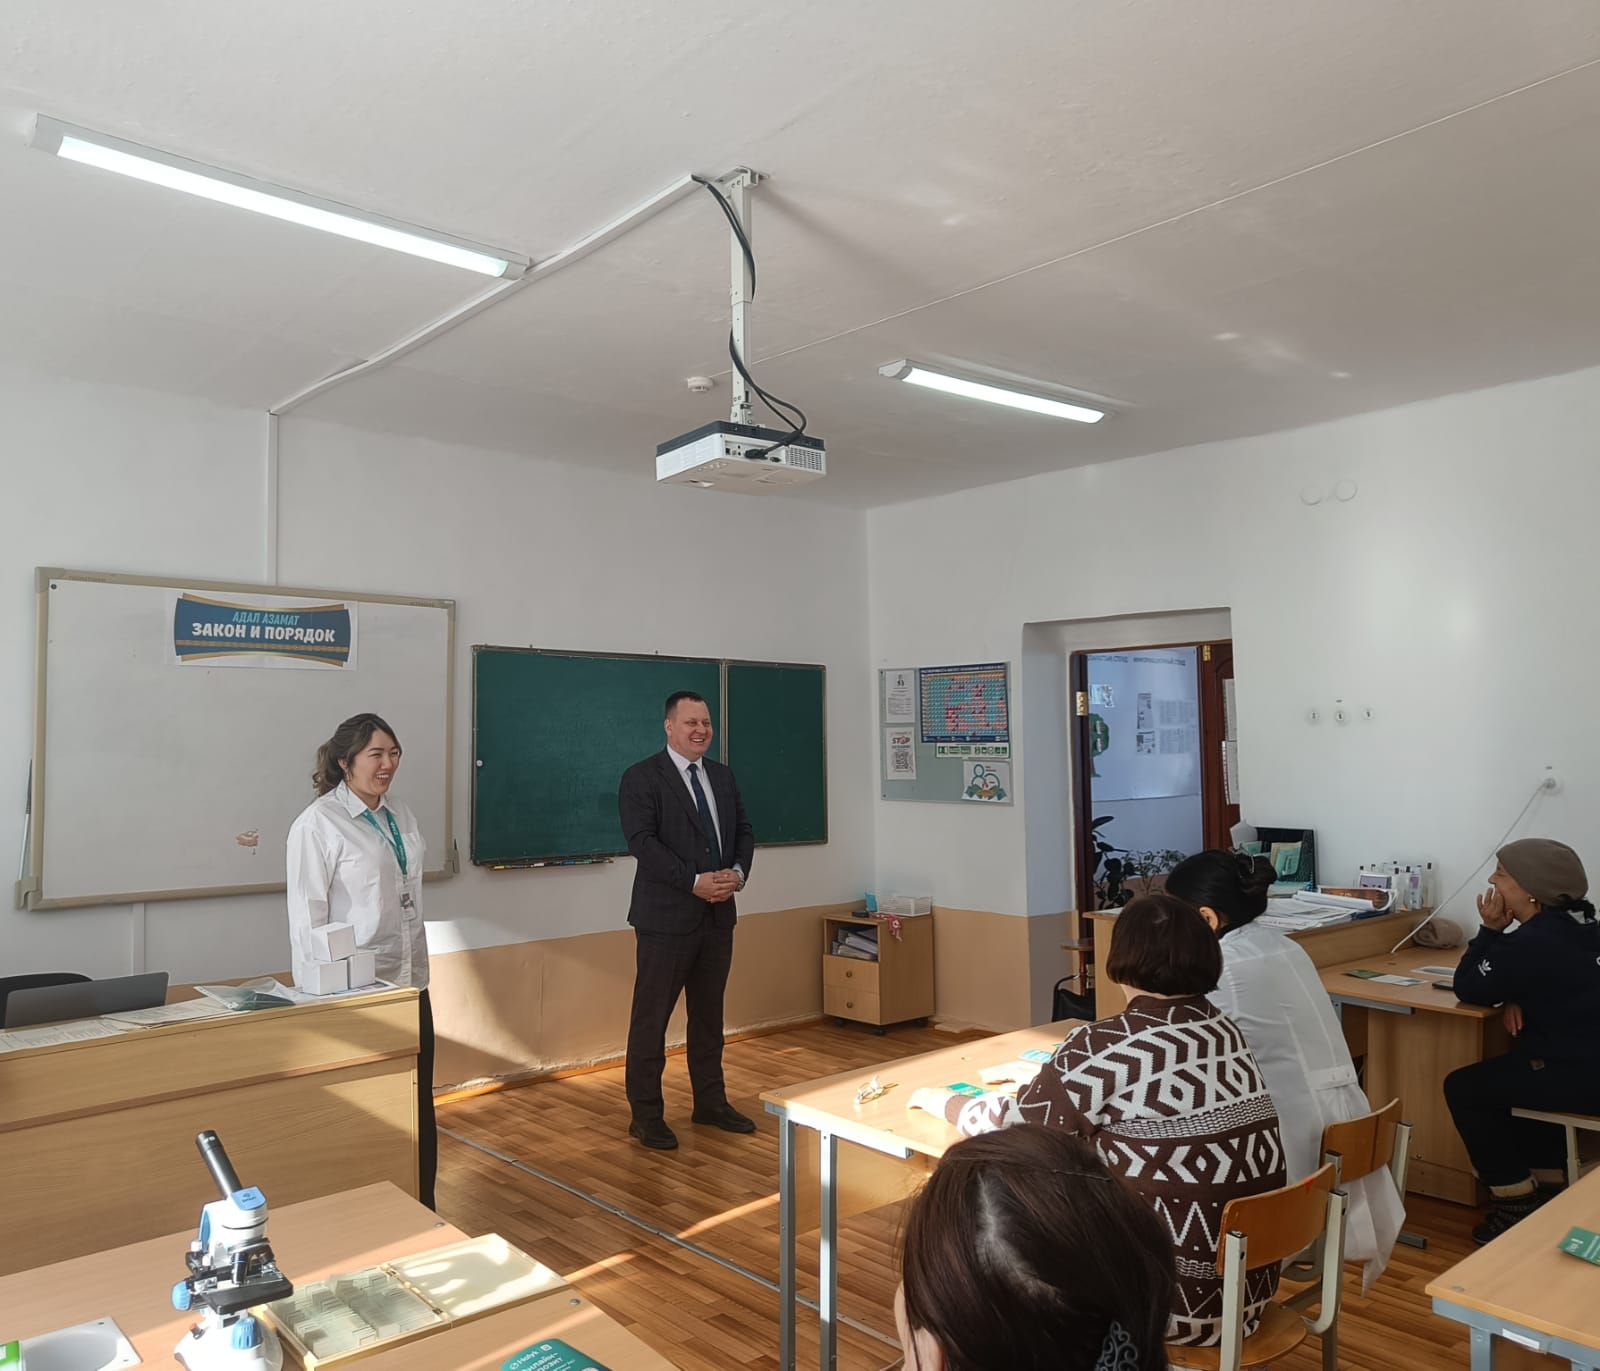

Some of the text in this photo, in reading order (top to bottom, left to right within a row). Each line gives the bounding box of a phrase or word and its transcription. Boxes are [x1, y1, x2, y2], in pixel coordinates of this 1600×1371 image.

[232, 611, 300, 626] АДАЛ АЗАМАТ
[192, 622, 335, 643] ЗАКОН И ПОРЯДОК
